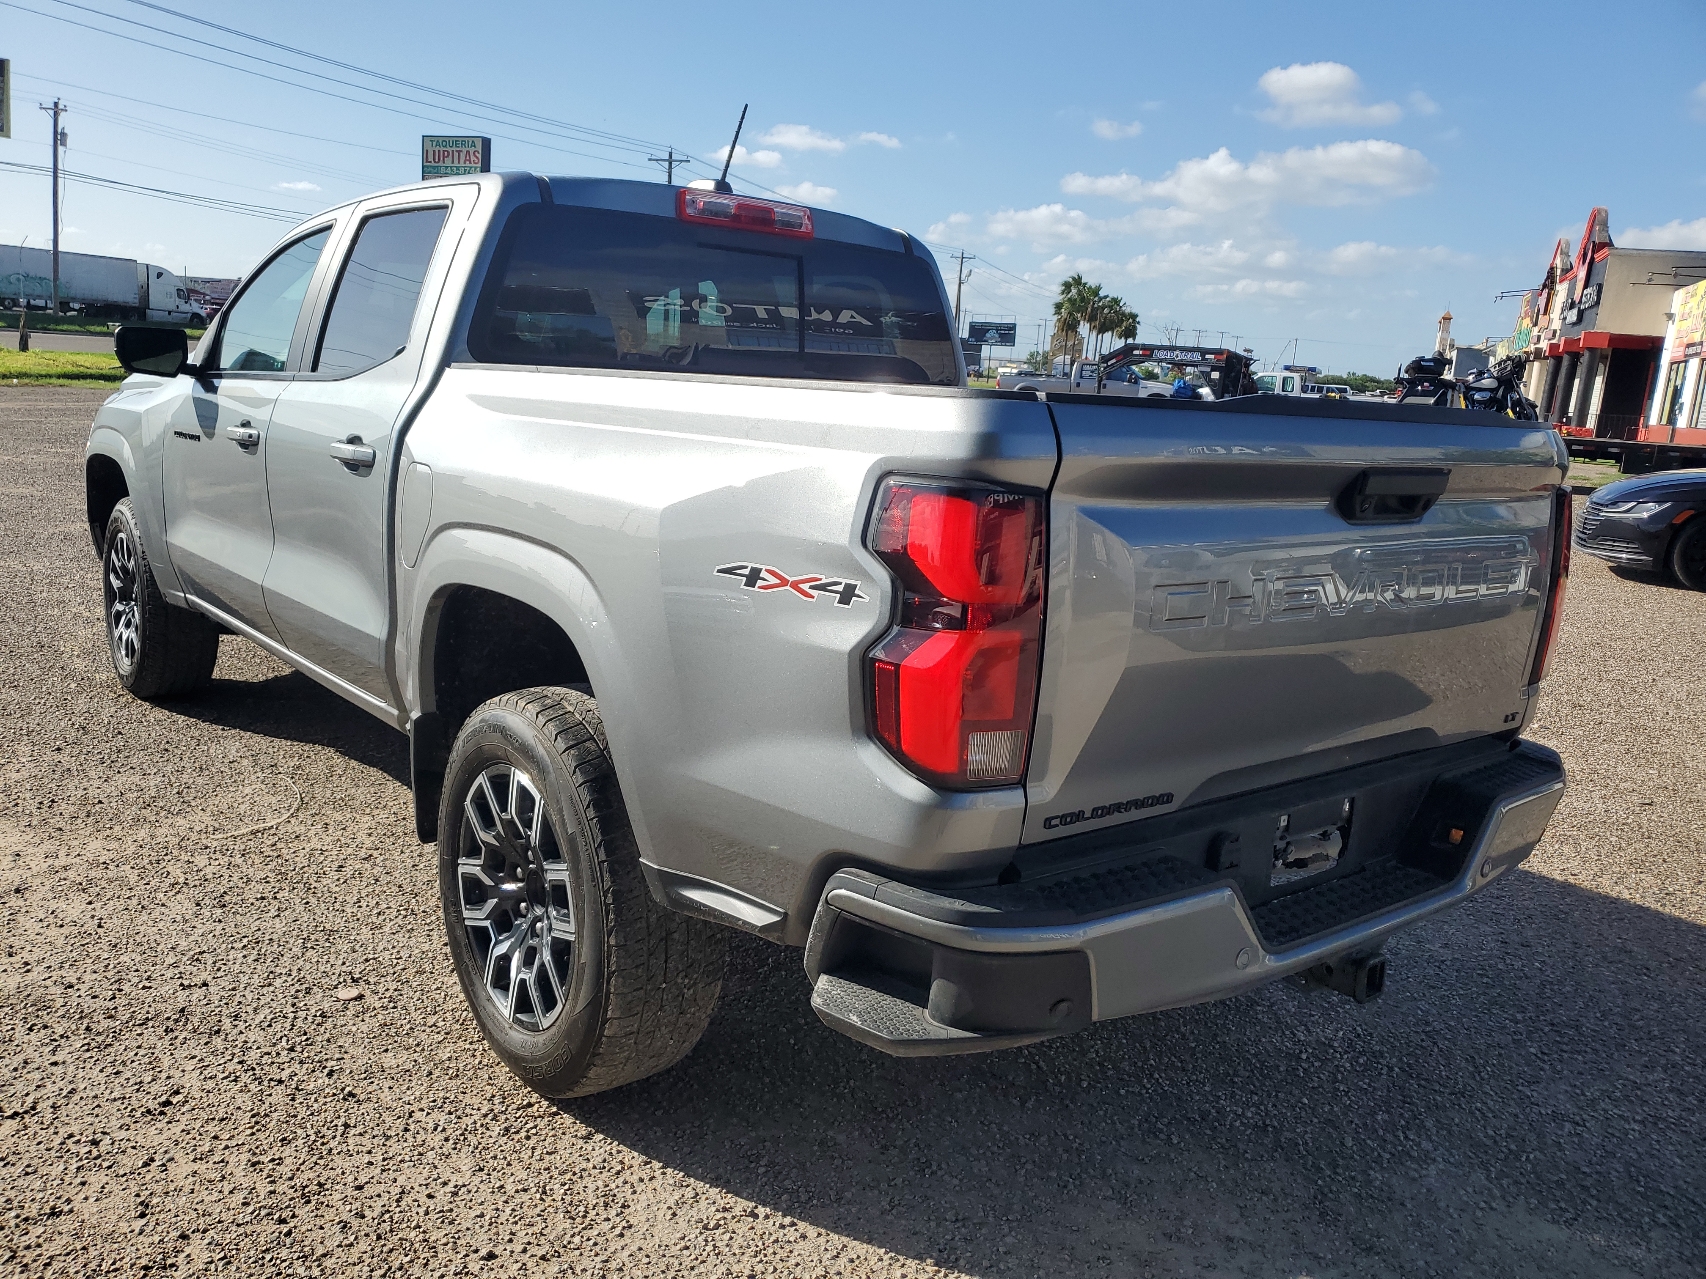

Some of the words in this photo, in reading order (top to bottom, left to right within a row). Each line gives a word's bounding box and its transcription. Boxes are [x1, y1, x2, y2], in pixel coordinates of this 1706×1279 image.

[425, 149, 480, 164] LUPITAS
[1152, 349, 1176, 359] LOAD
[1179, 350, 1202, 361] TRAIL
[1043, 791, 1175, 830] COLORADO
